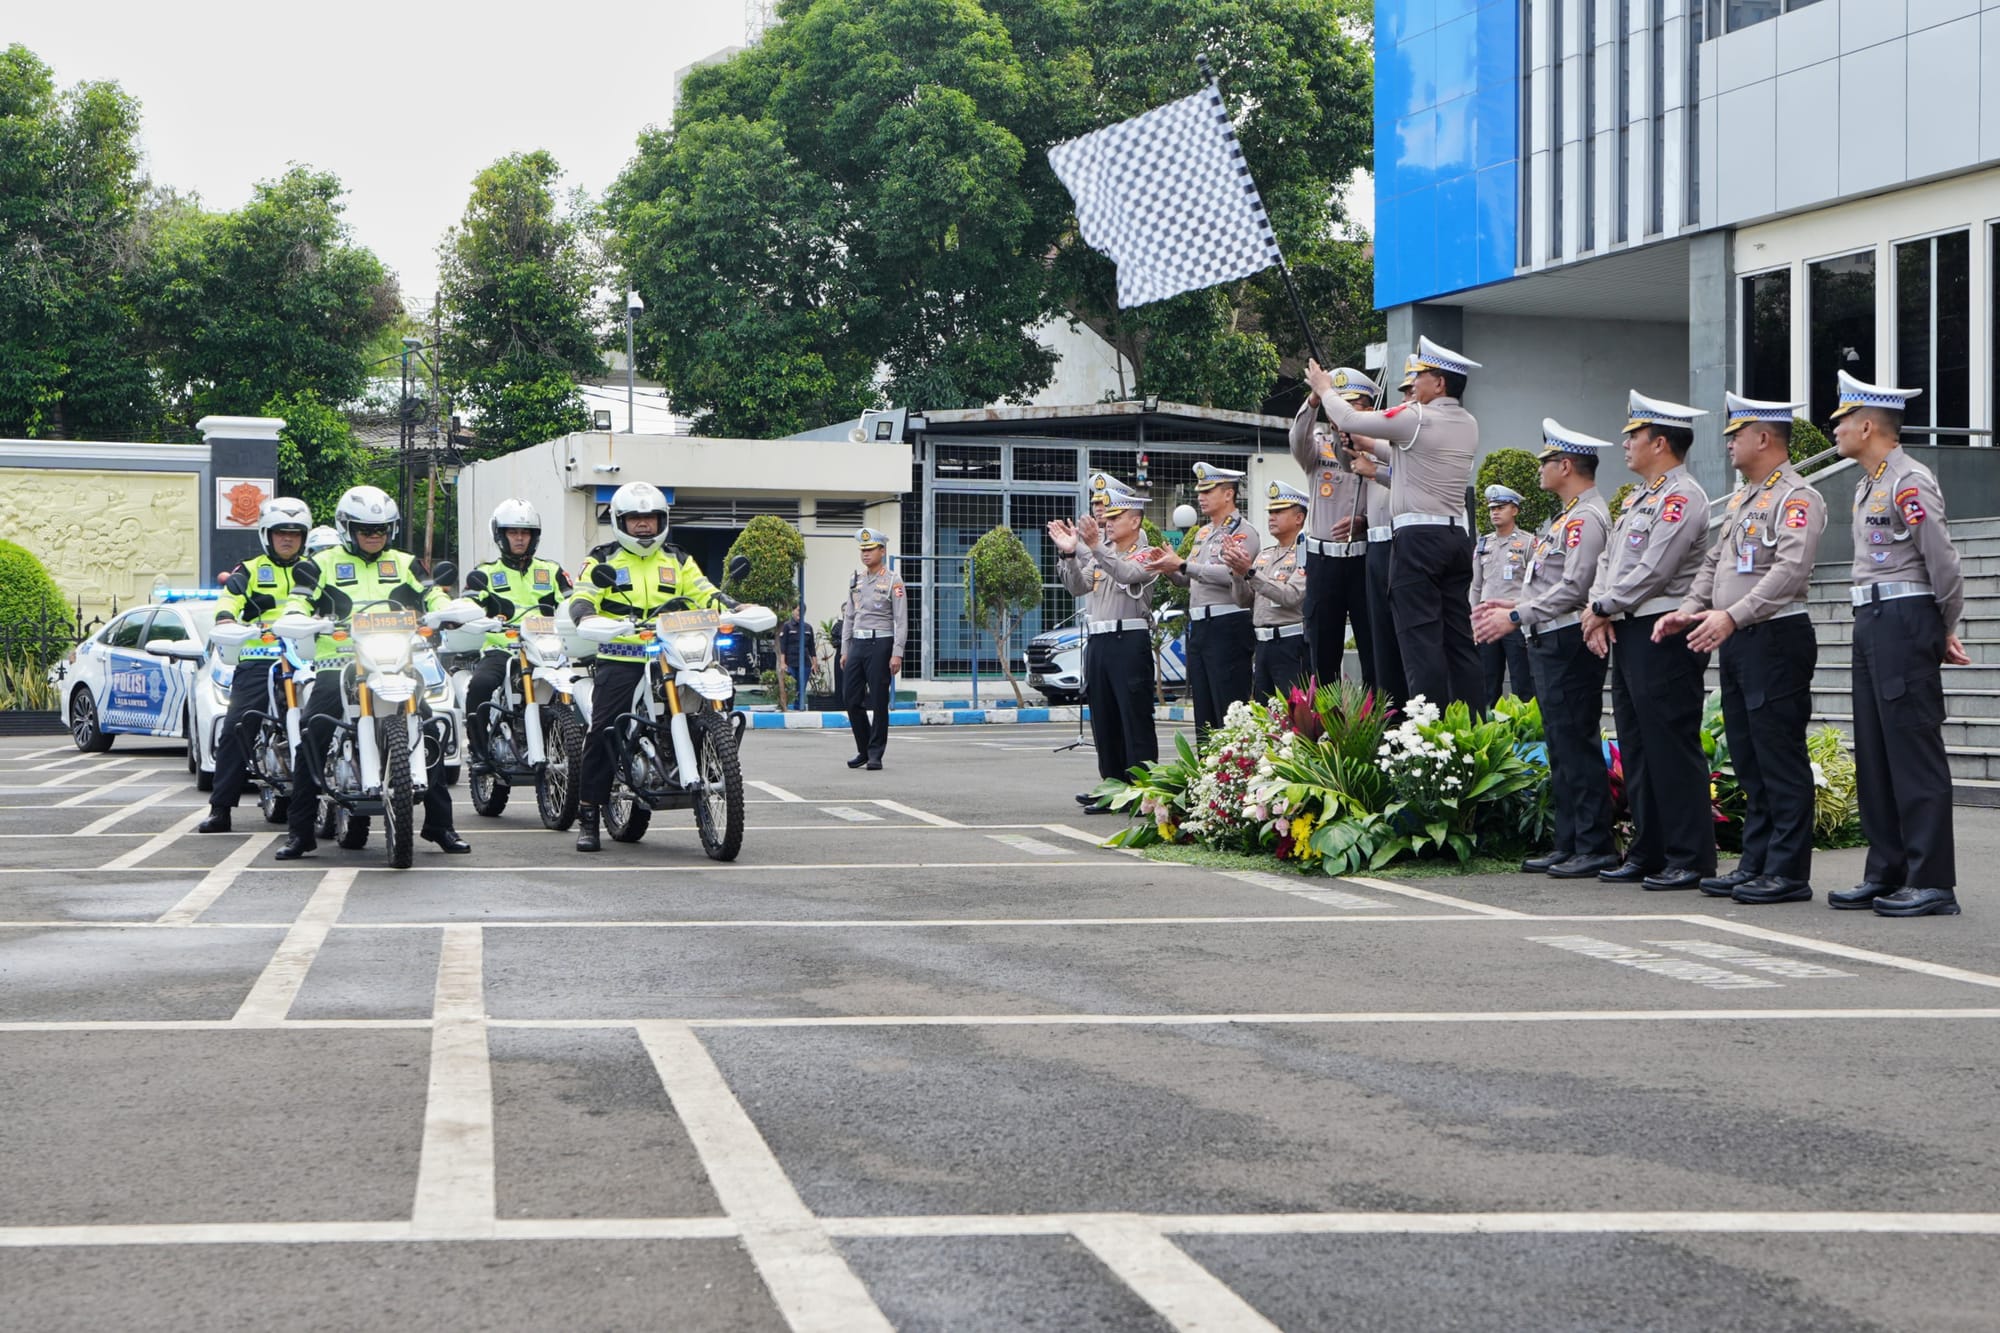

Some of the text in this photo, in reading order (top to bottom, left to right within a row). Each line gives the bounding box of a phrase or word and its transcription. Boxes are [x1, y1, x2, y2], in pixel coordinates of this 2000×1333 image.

[1747, 511, 1768, 521] POLRI
[1865, 516, 1890, 526] POLRI
[113, 672, 146, 694] POLISI
